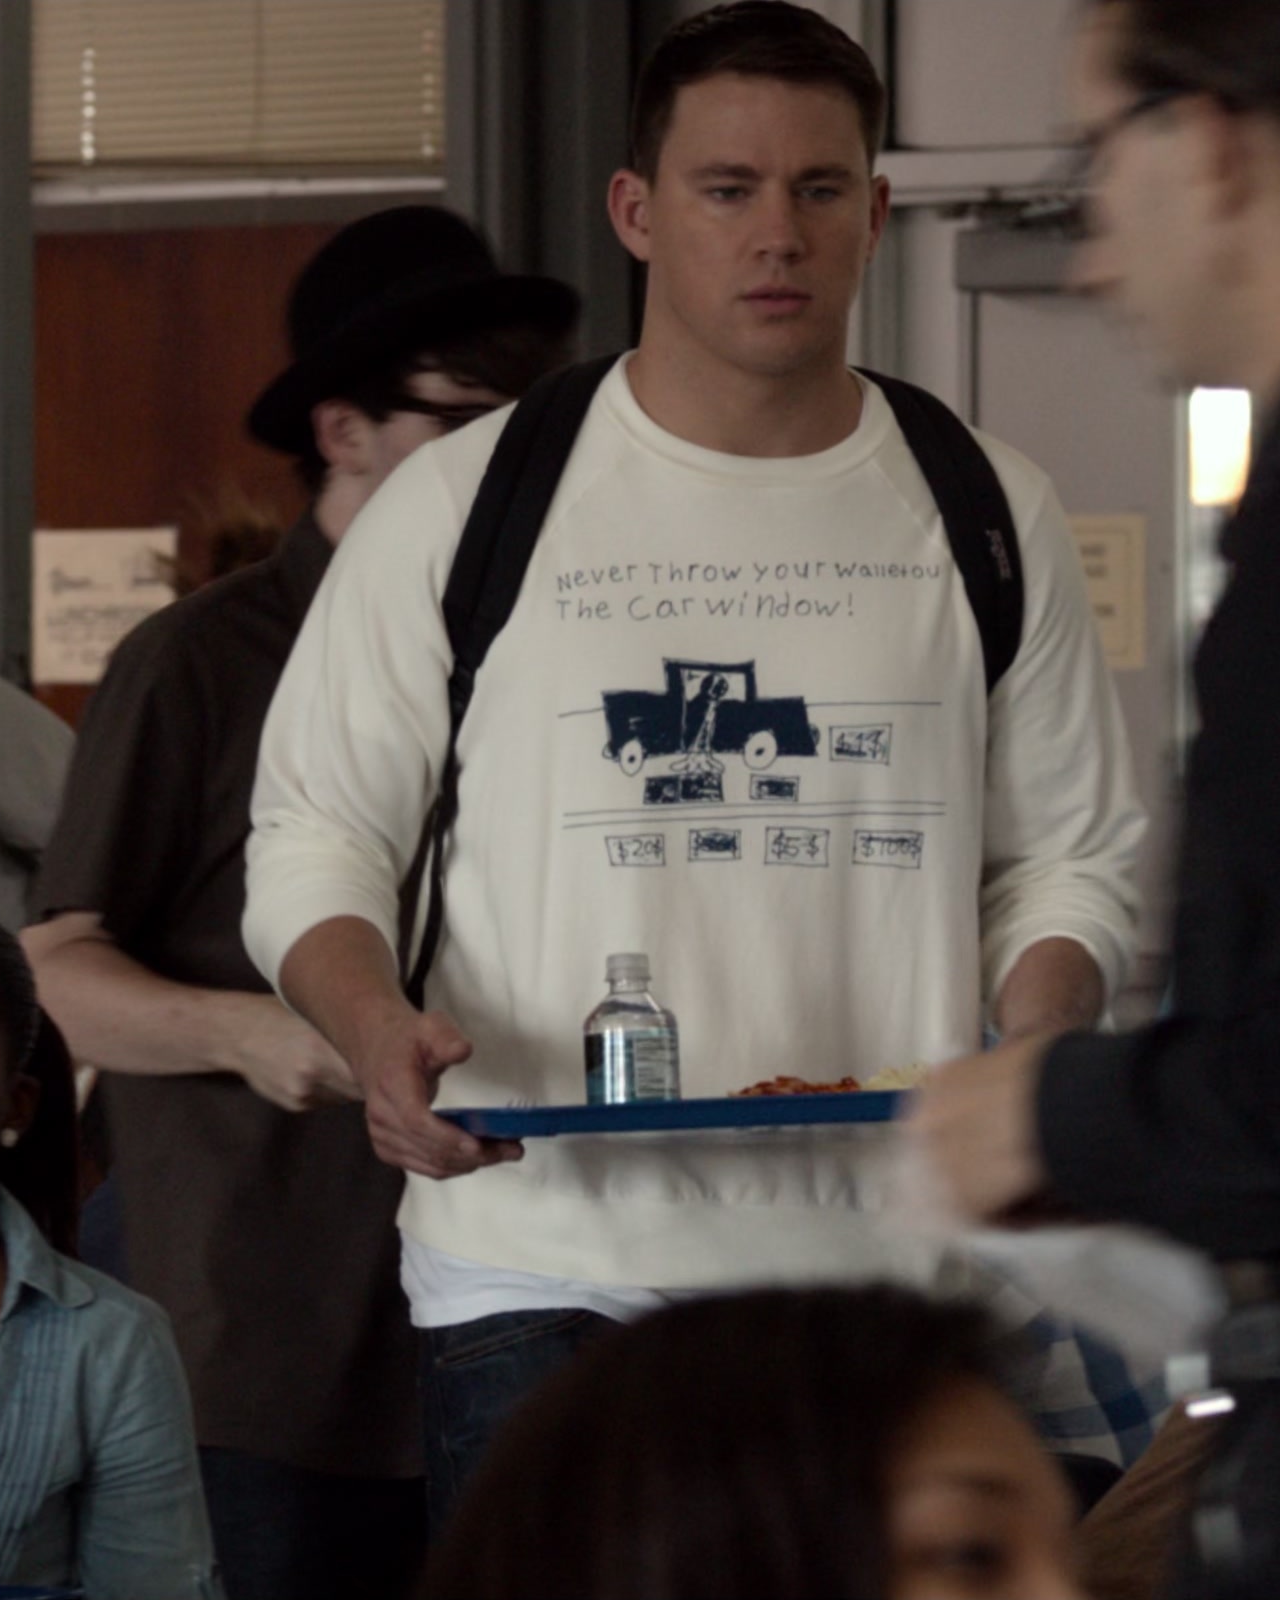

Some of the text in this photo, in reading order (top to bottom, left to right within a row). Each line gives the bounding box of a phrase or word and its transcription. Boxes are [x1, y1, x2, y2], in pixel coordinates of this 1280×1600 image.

[557, 565, 638, 592] Never
[648, 562, 742, 584] Throw
[556, 596, 613, 621] The
[627, 595, 695, 621] Car
